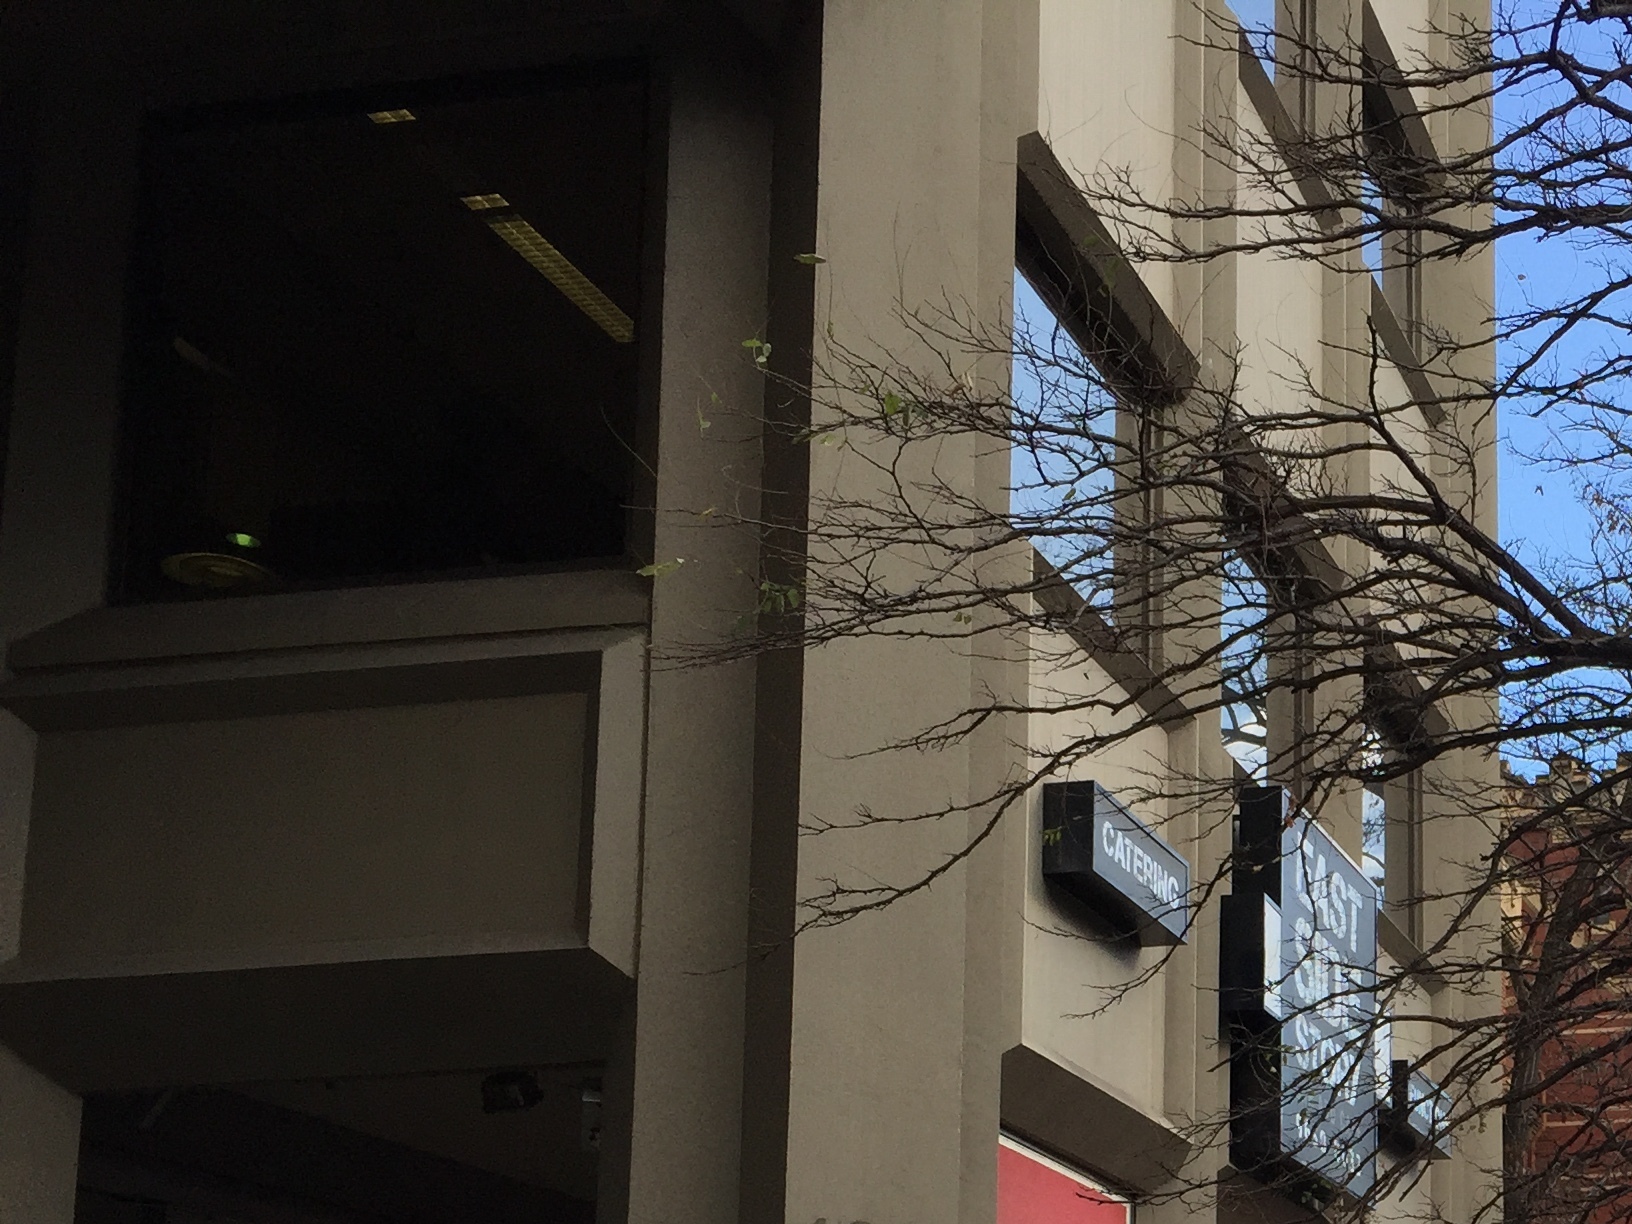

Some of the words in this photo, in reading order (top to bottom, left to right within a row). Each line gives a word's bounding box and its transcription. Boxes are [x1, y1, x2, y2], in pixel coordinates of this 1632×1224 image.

[1103, 821, 1180, 909] CATERING
[1296, 830, 1363, 953] EAST
[1295, 917, 1363, 1042] SIDE
